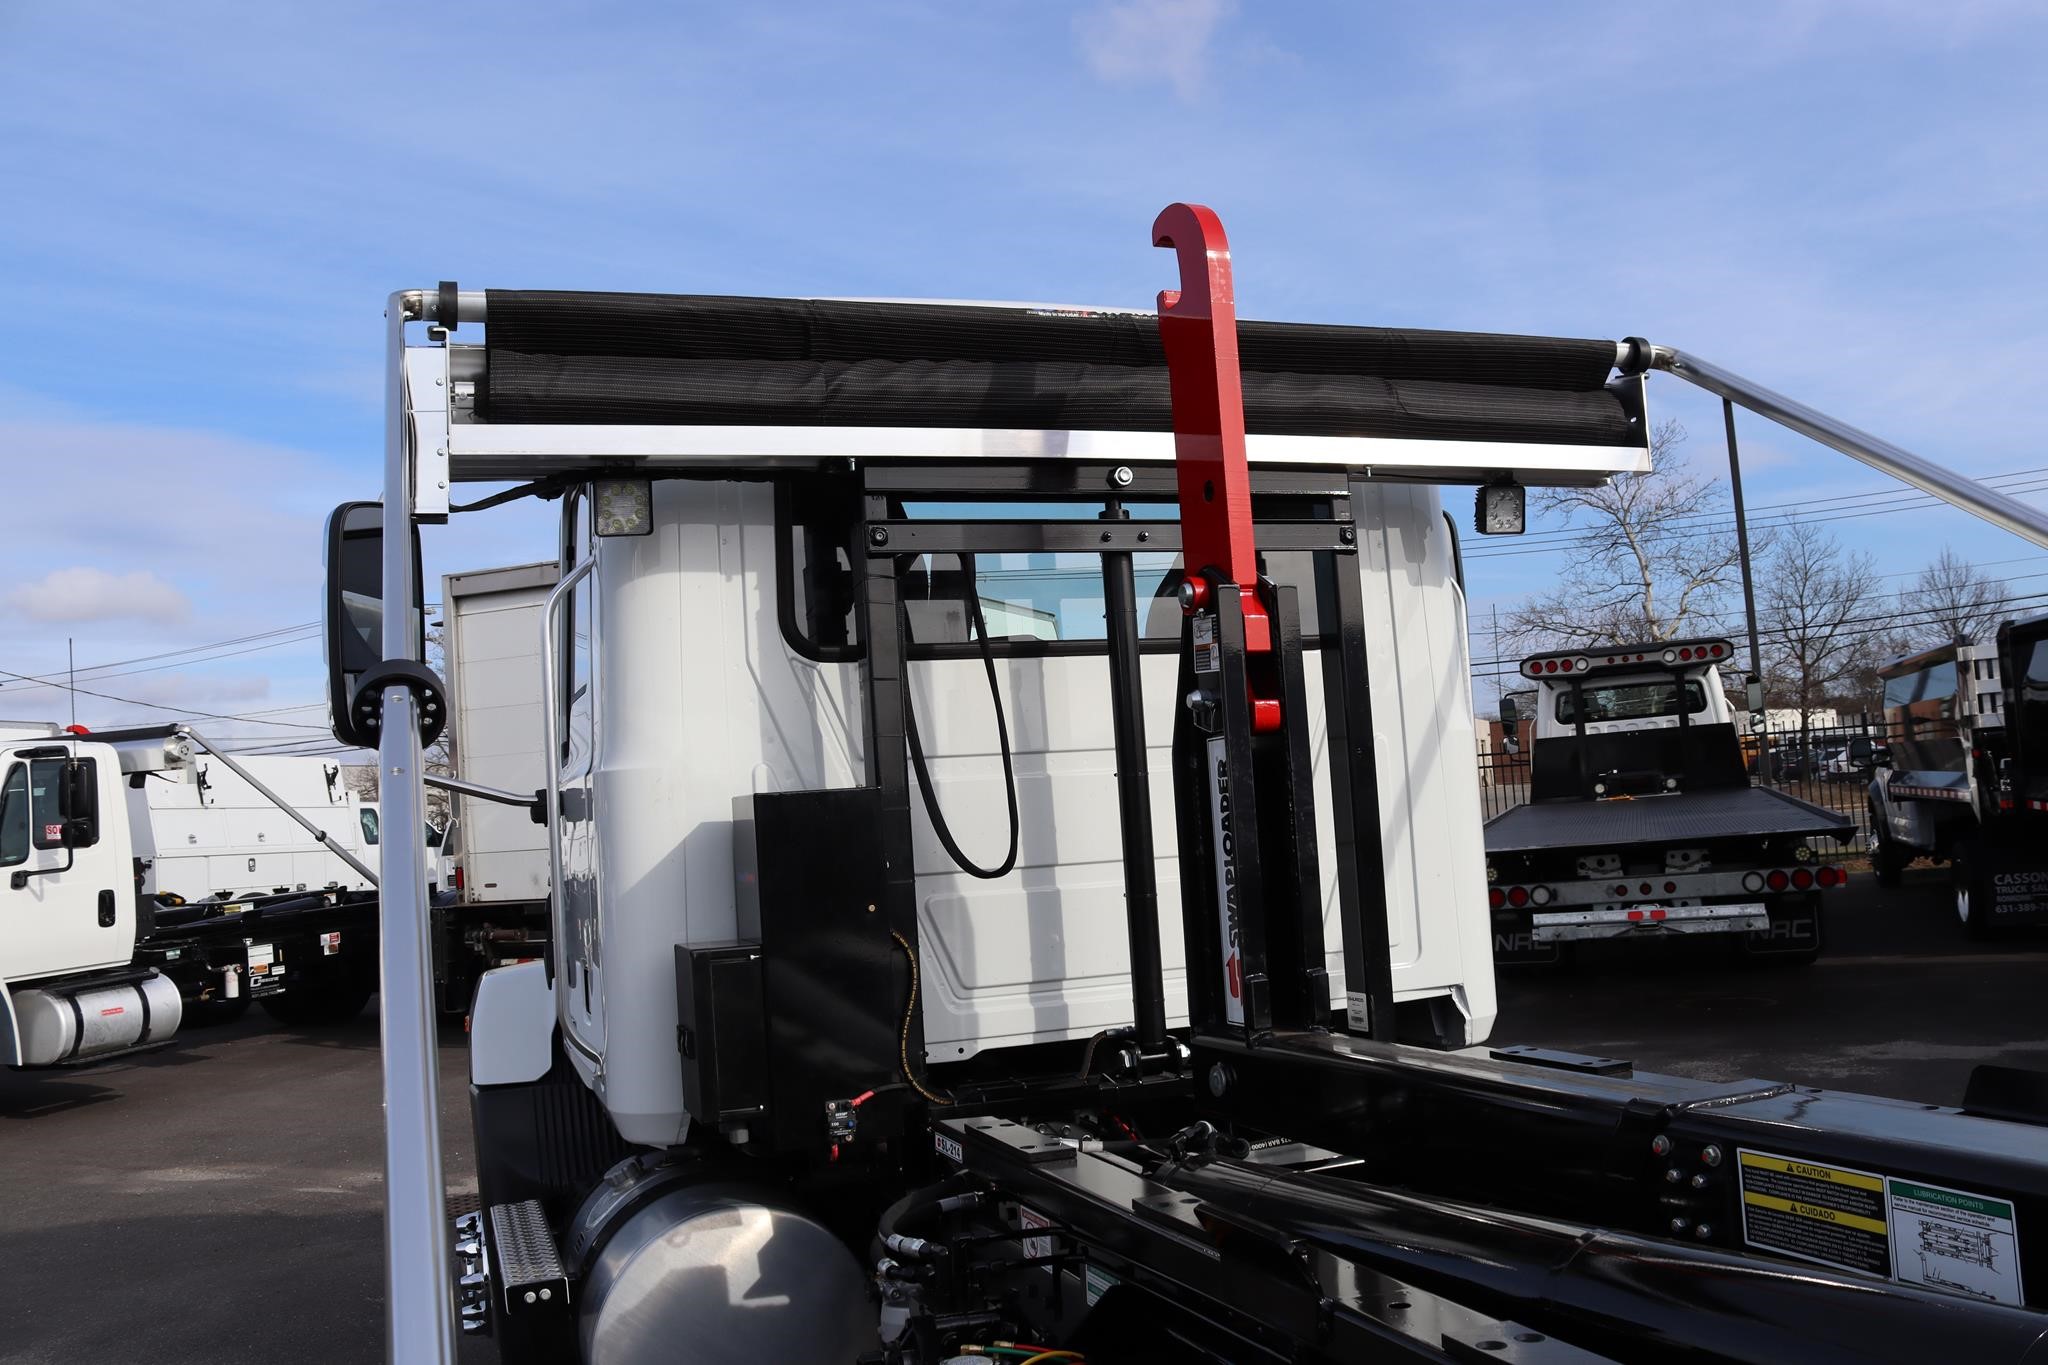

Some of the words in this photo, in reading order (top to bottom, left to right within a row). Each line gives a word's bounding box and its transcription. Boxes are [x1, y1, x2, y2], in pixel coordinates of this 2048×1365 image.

[1216, 760, 1239, 950] SWAPLOADER
[1996, 885, 2028, 894] TRUCK
[941, 1137, 961, 1158] SL-214
[1268, 1138, 1281, 1147] BAR
[1796, 1165, 1831, 1179] CAUTION
[1913, 1189, 1957, 1205] LUBRICATION
[1958, 1198, 1984, 1210] POINTS
[1800, 1205, 1836, 1220] CUIDADO
